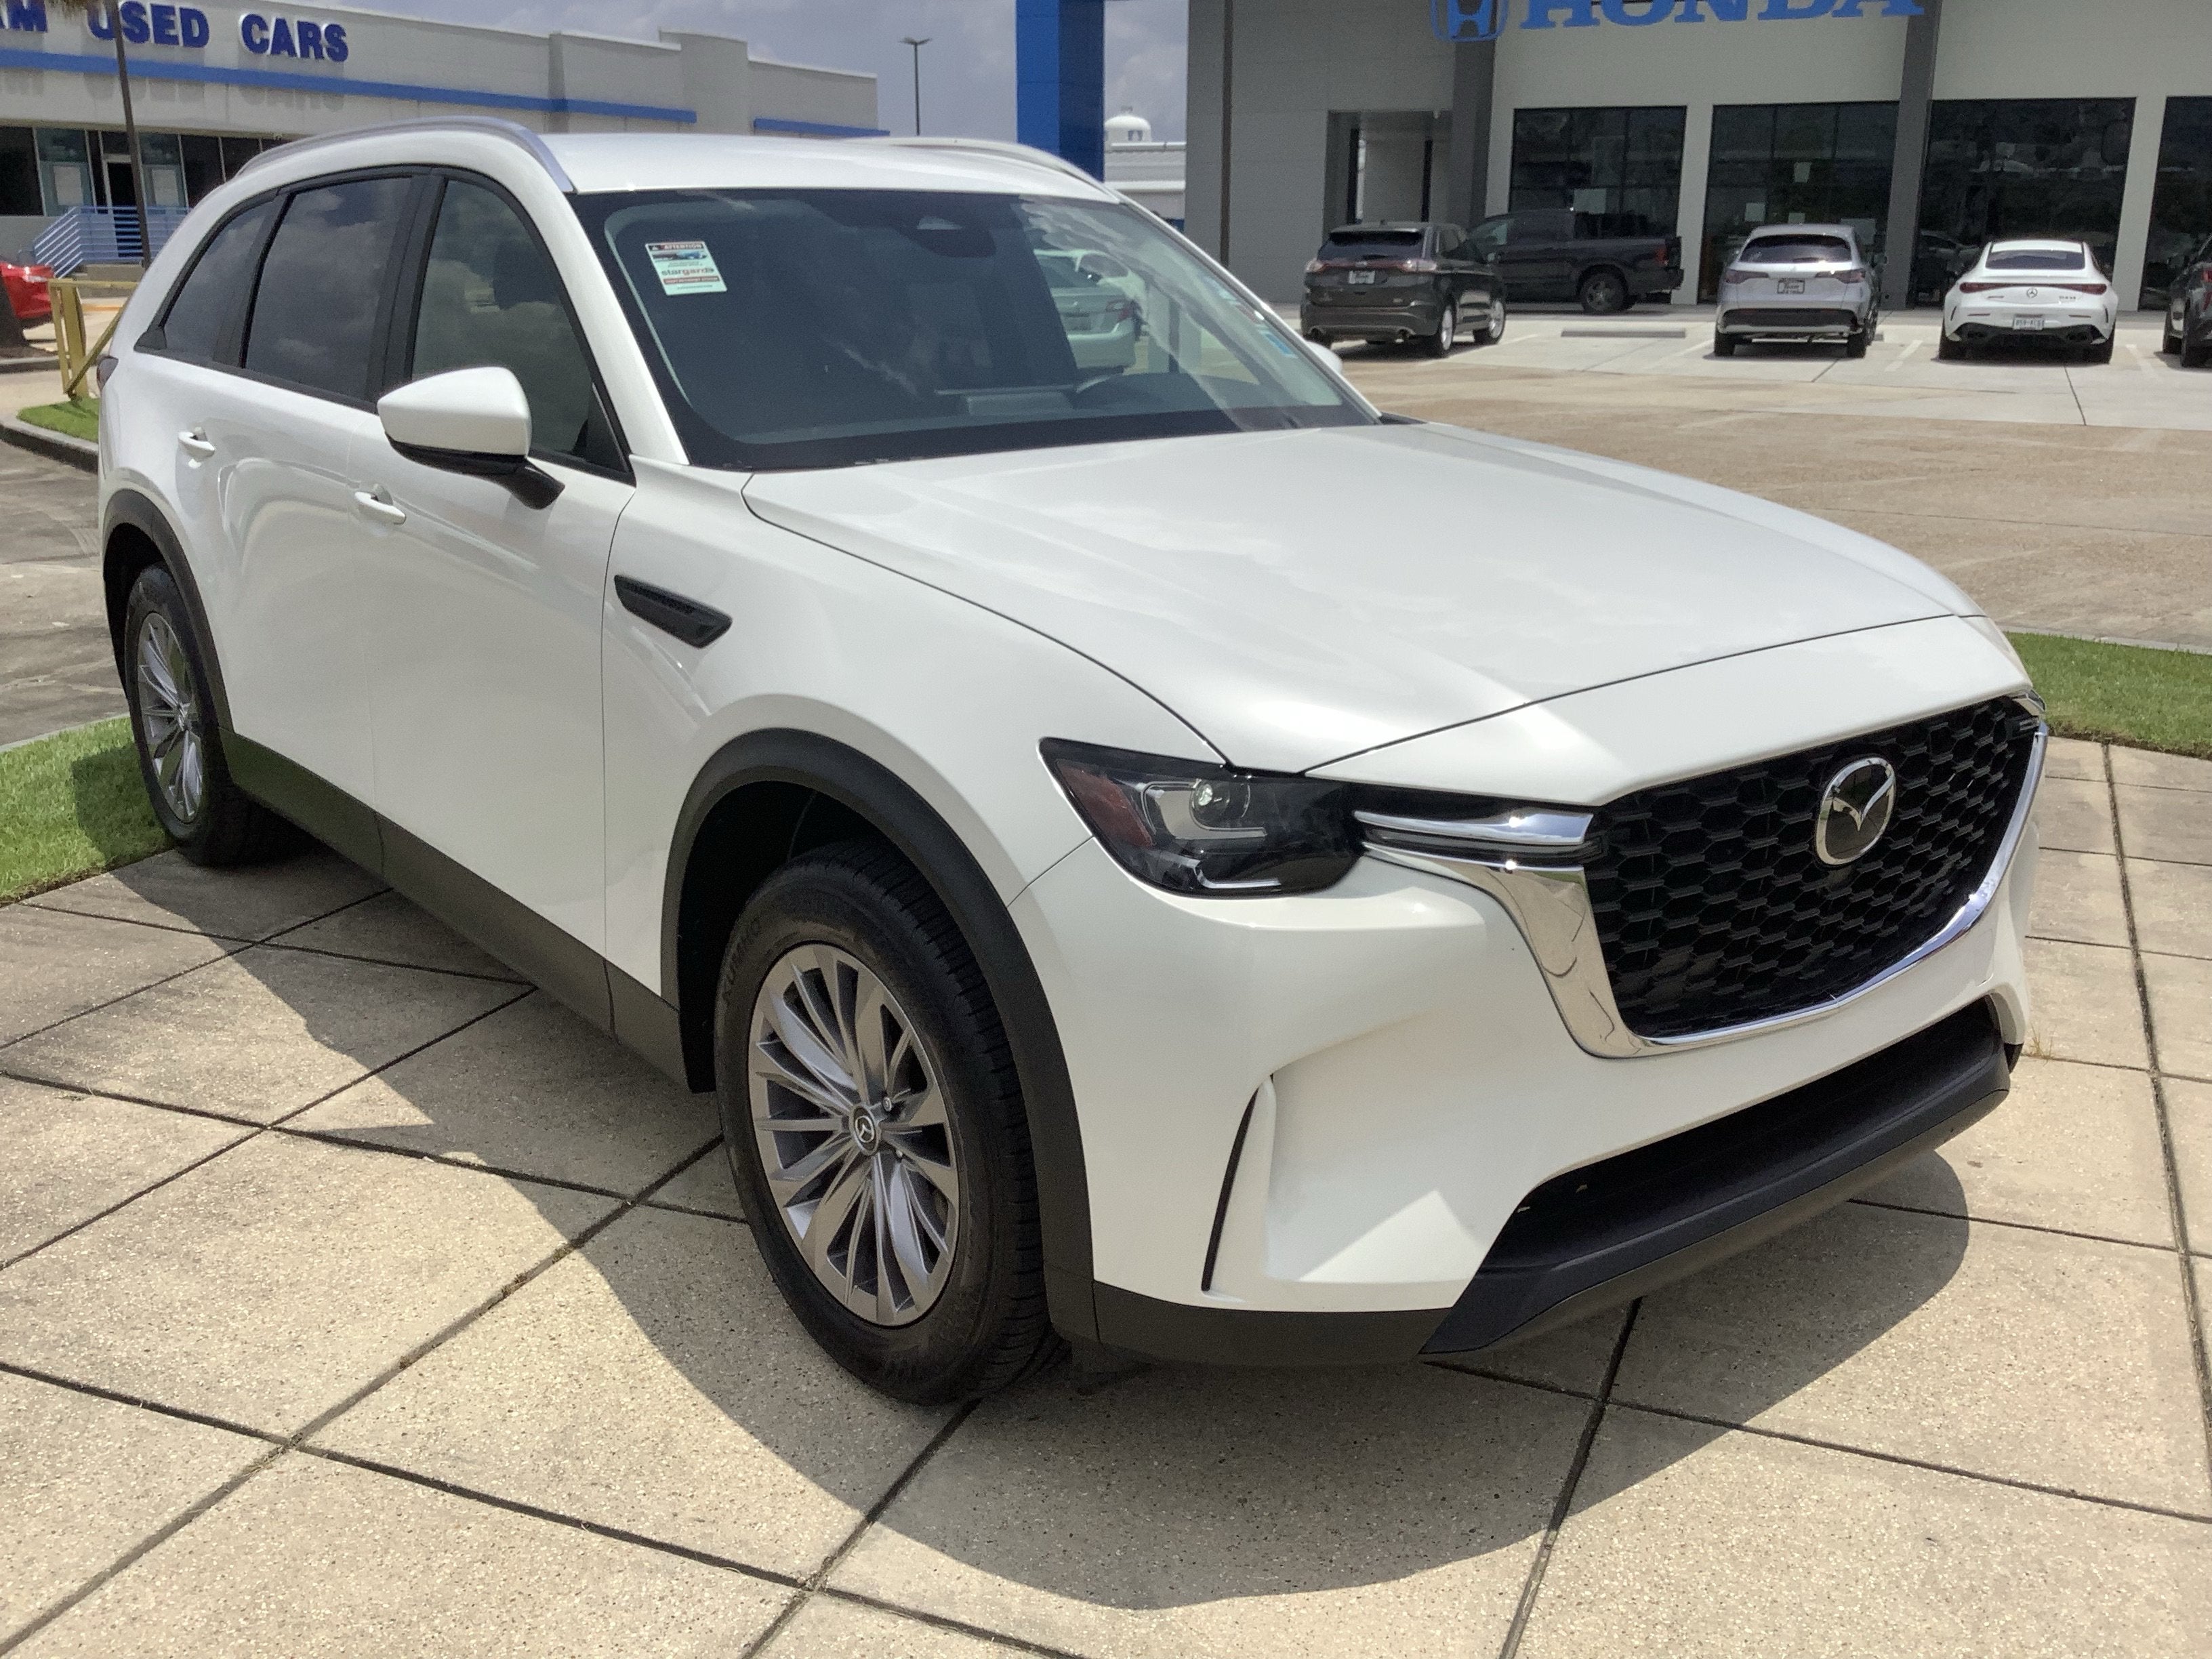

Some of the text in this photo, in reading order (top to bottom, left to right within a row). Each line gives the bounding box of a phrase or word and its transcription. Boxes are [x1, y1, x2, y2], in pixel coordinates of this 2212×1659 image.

[0, 0, 349, 62] M USED CARS
